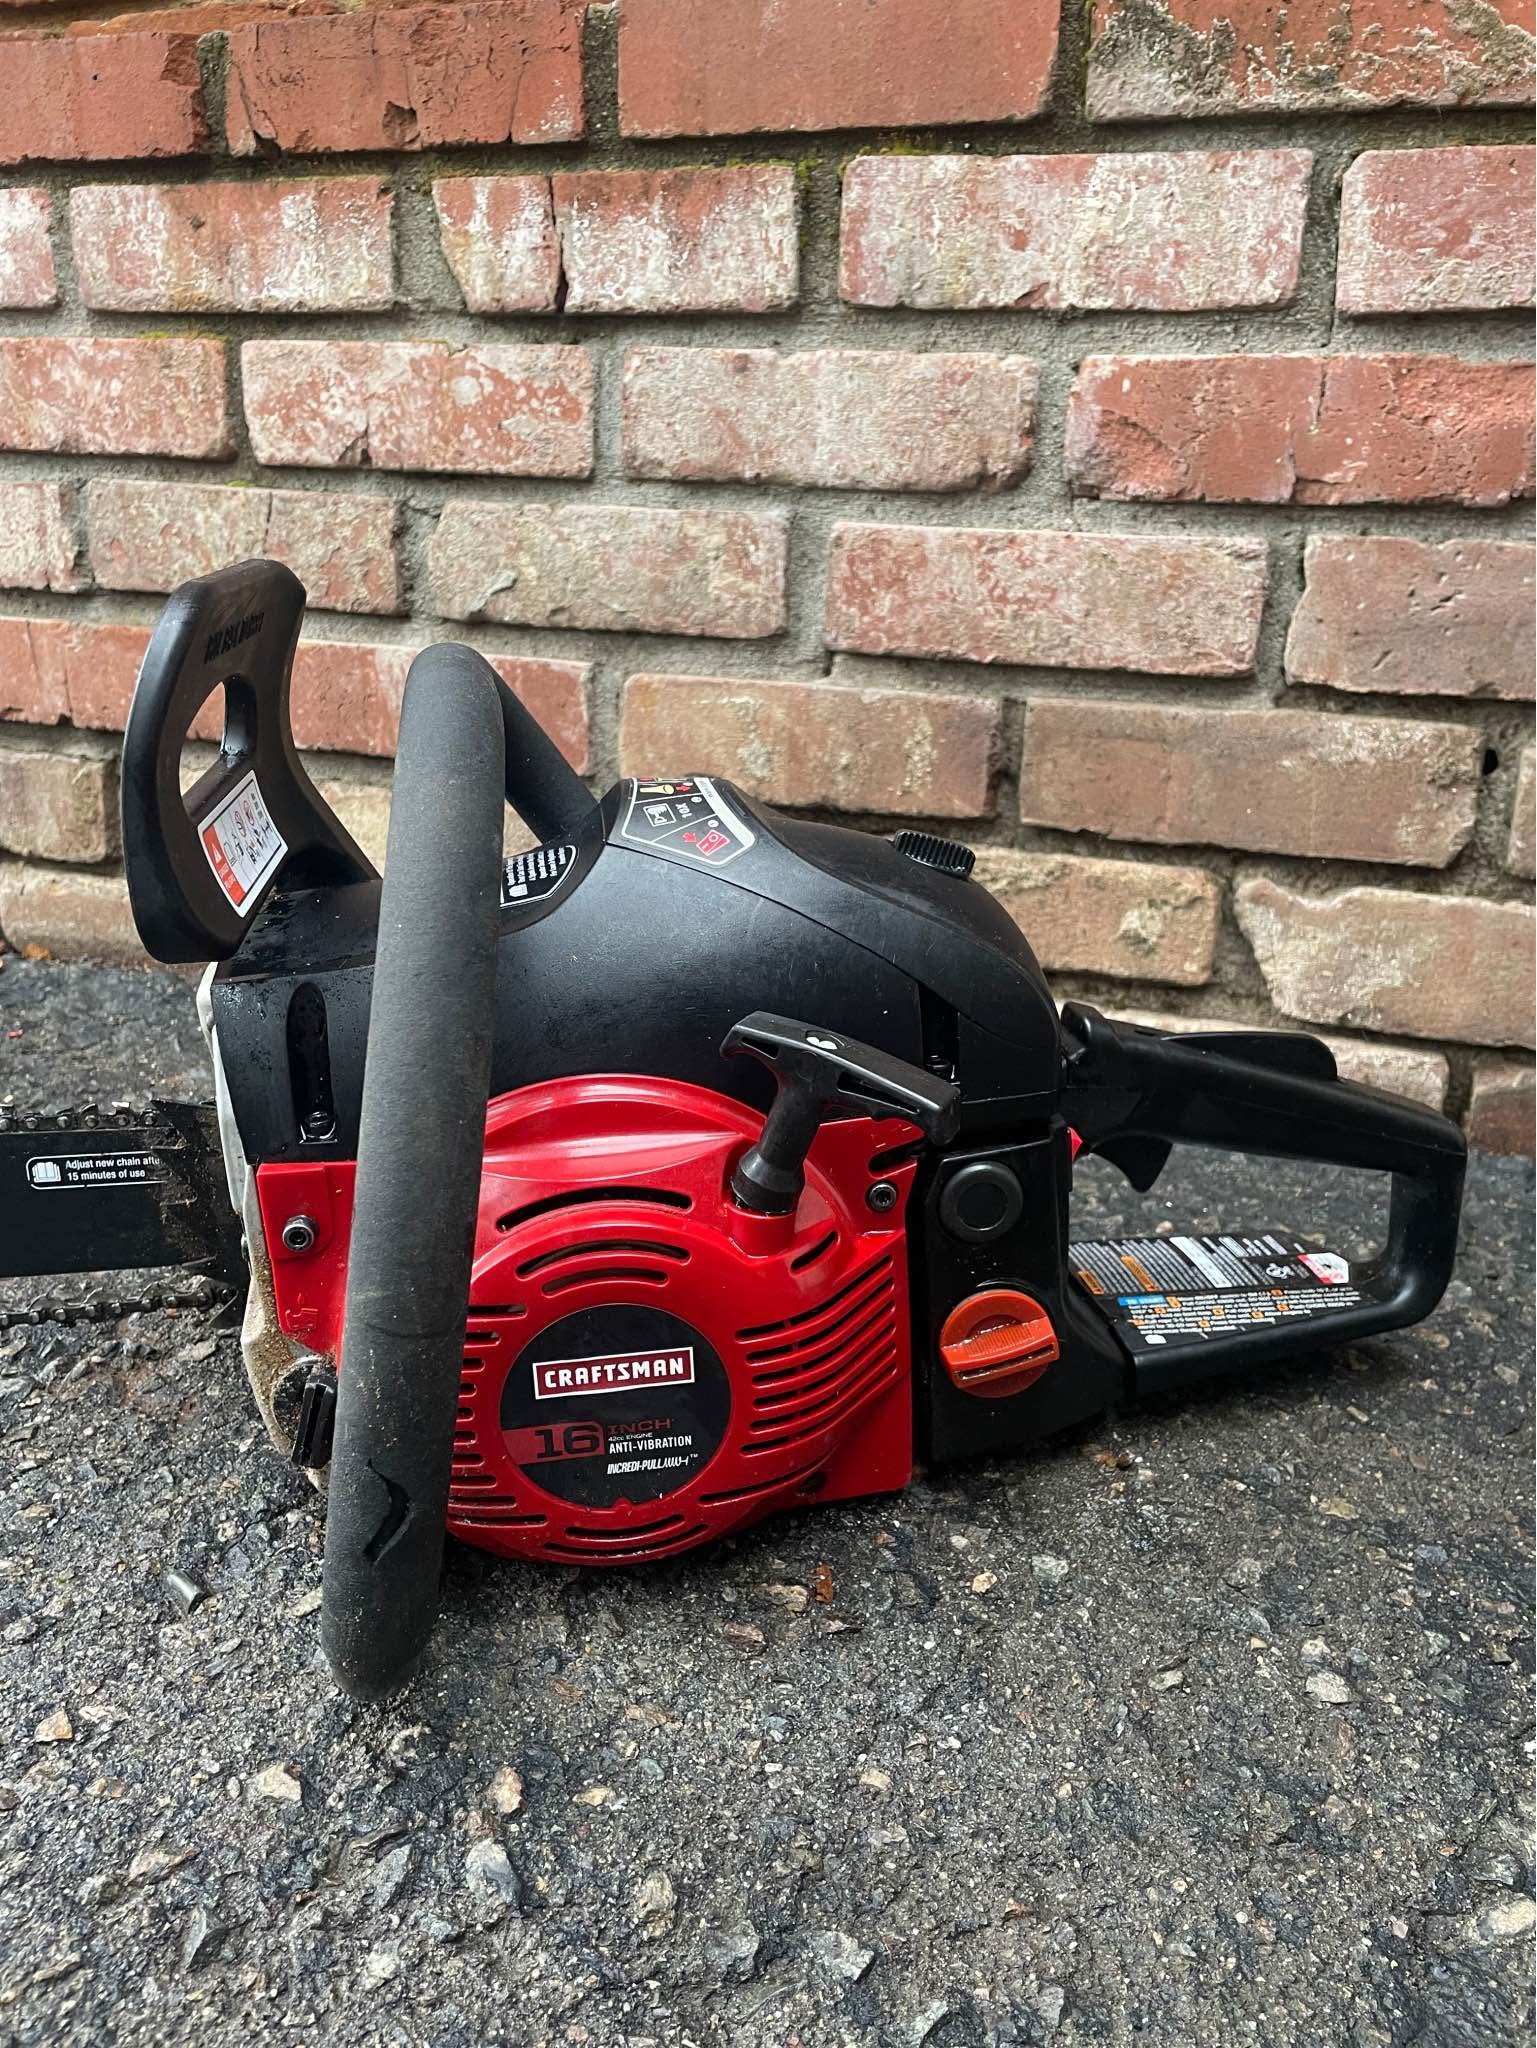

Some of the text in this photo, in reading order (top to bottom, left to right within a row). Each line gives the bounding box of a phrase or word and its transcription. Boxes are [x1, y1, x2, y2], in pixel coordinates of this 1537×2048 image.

[65, 1159, 94, 1170] Adjust
[116, 1157, 140, 1166] chain
[142, 1156, 164, 1165] afte
[67, 1169, 146, 1181] 15 minutes of use
[545, 1357, 684, 1388] CRAFTSMAN
[535, 1419, 671, 1458] 16 INCH
[609, 1435, 692, 1453] ANTI-VIBRATION
[625, 1432, 653, 1440] ENGINE
